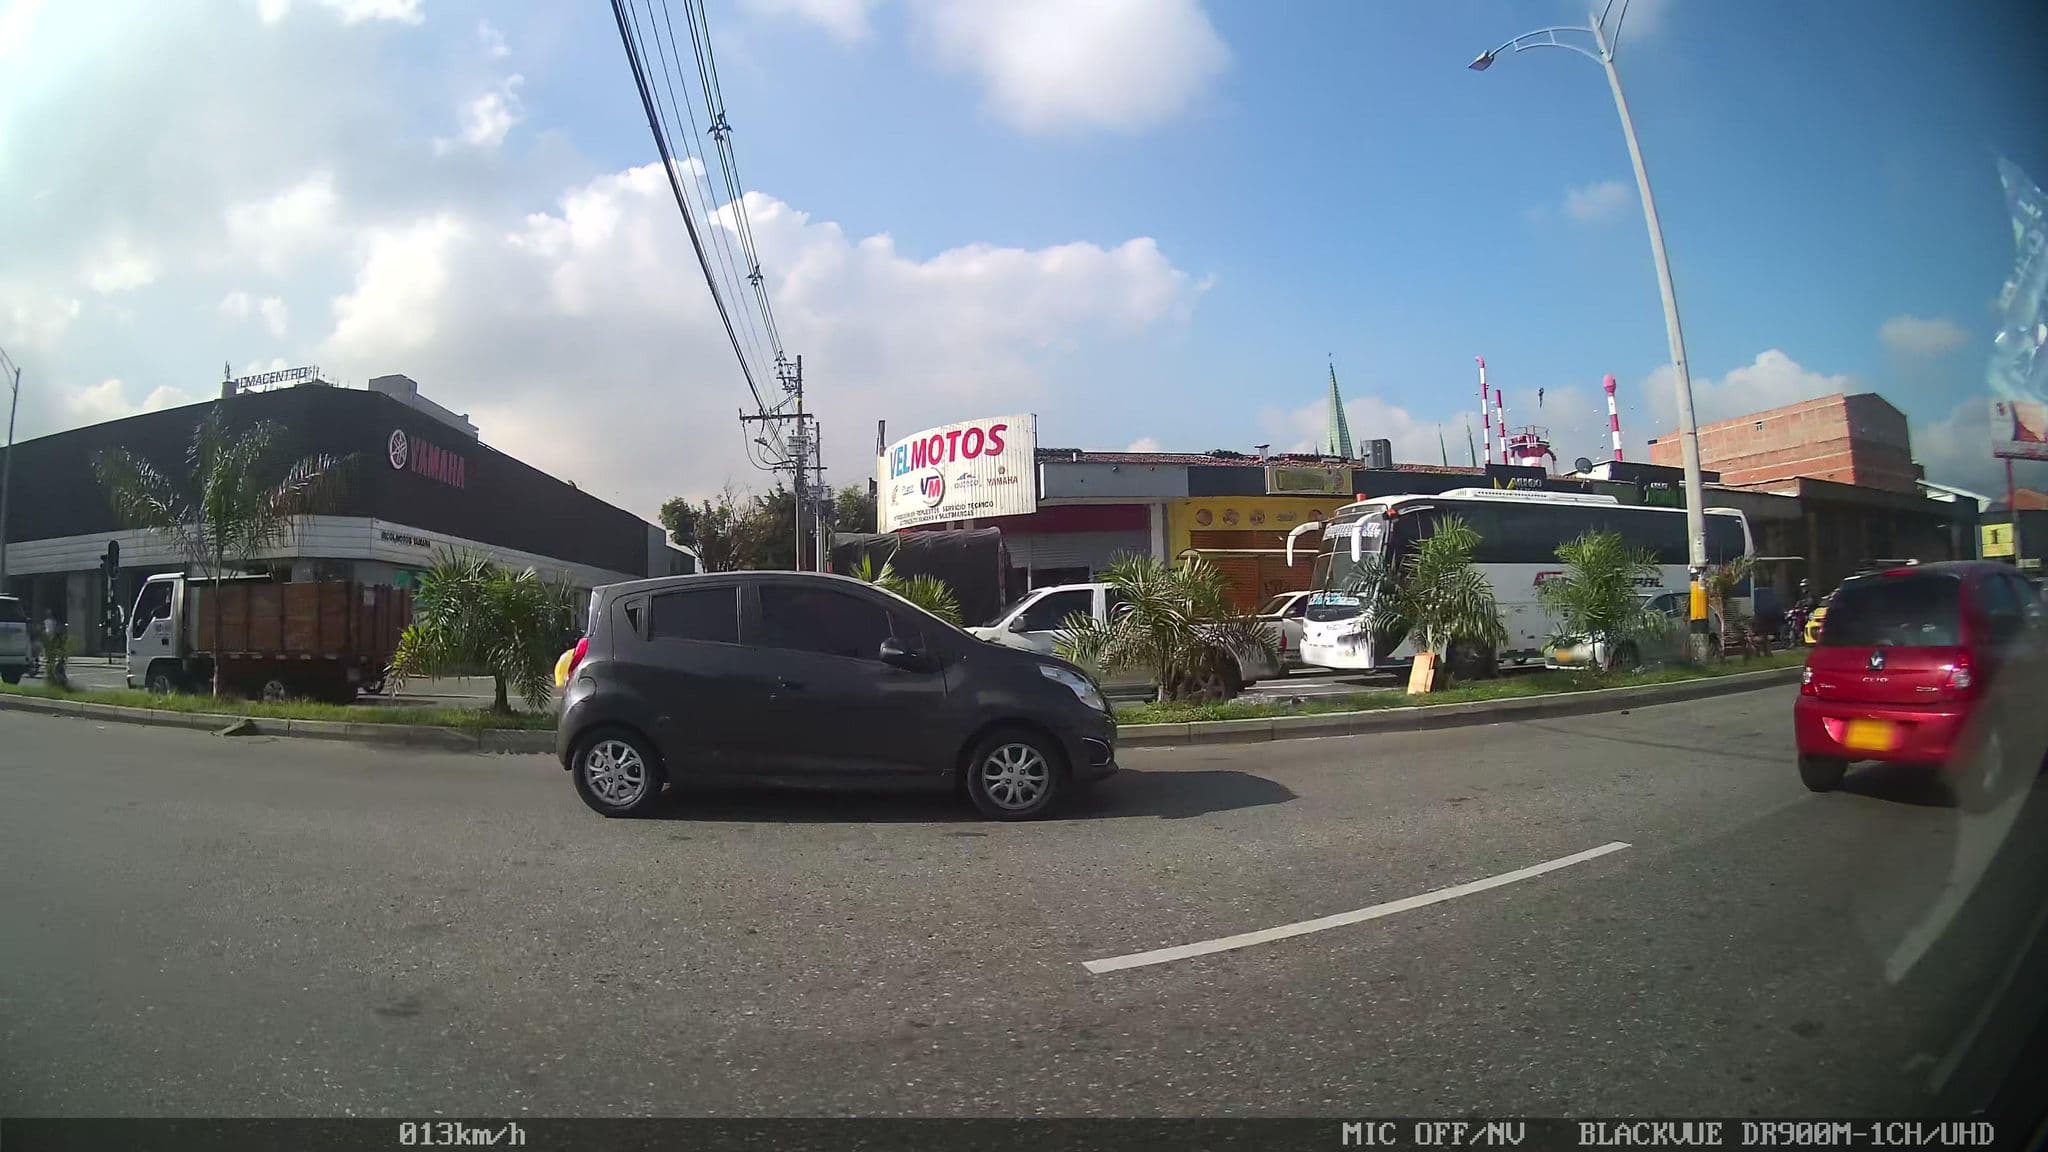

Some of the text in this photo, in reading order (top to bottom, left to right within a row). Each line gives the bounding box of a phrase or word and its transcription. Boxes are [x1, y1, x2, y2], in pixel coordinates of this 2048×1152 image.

[411, 435, 465, 489] YAMAHA
[889, 424, 1008, 480] VELMOTOS
[920, 475, 941, 498] VM
[986, 476, 1019, 487] YAMAHA
